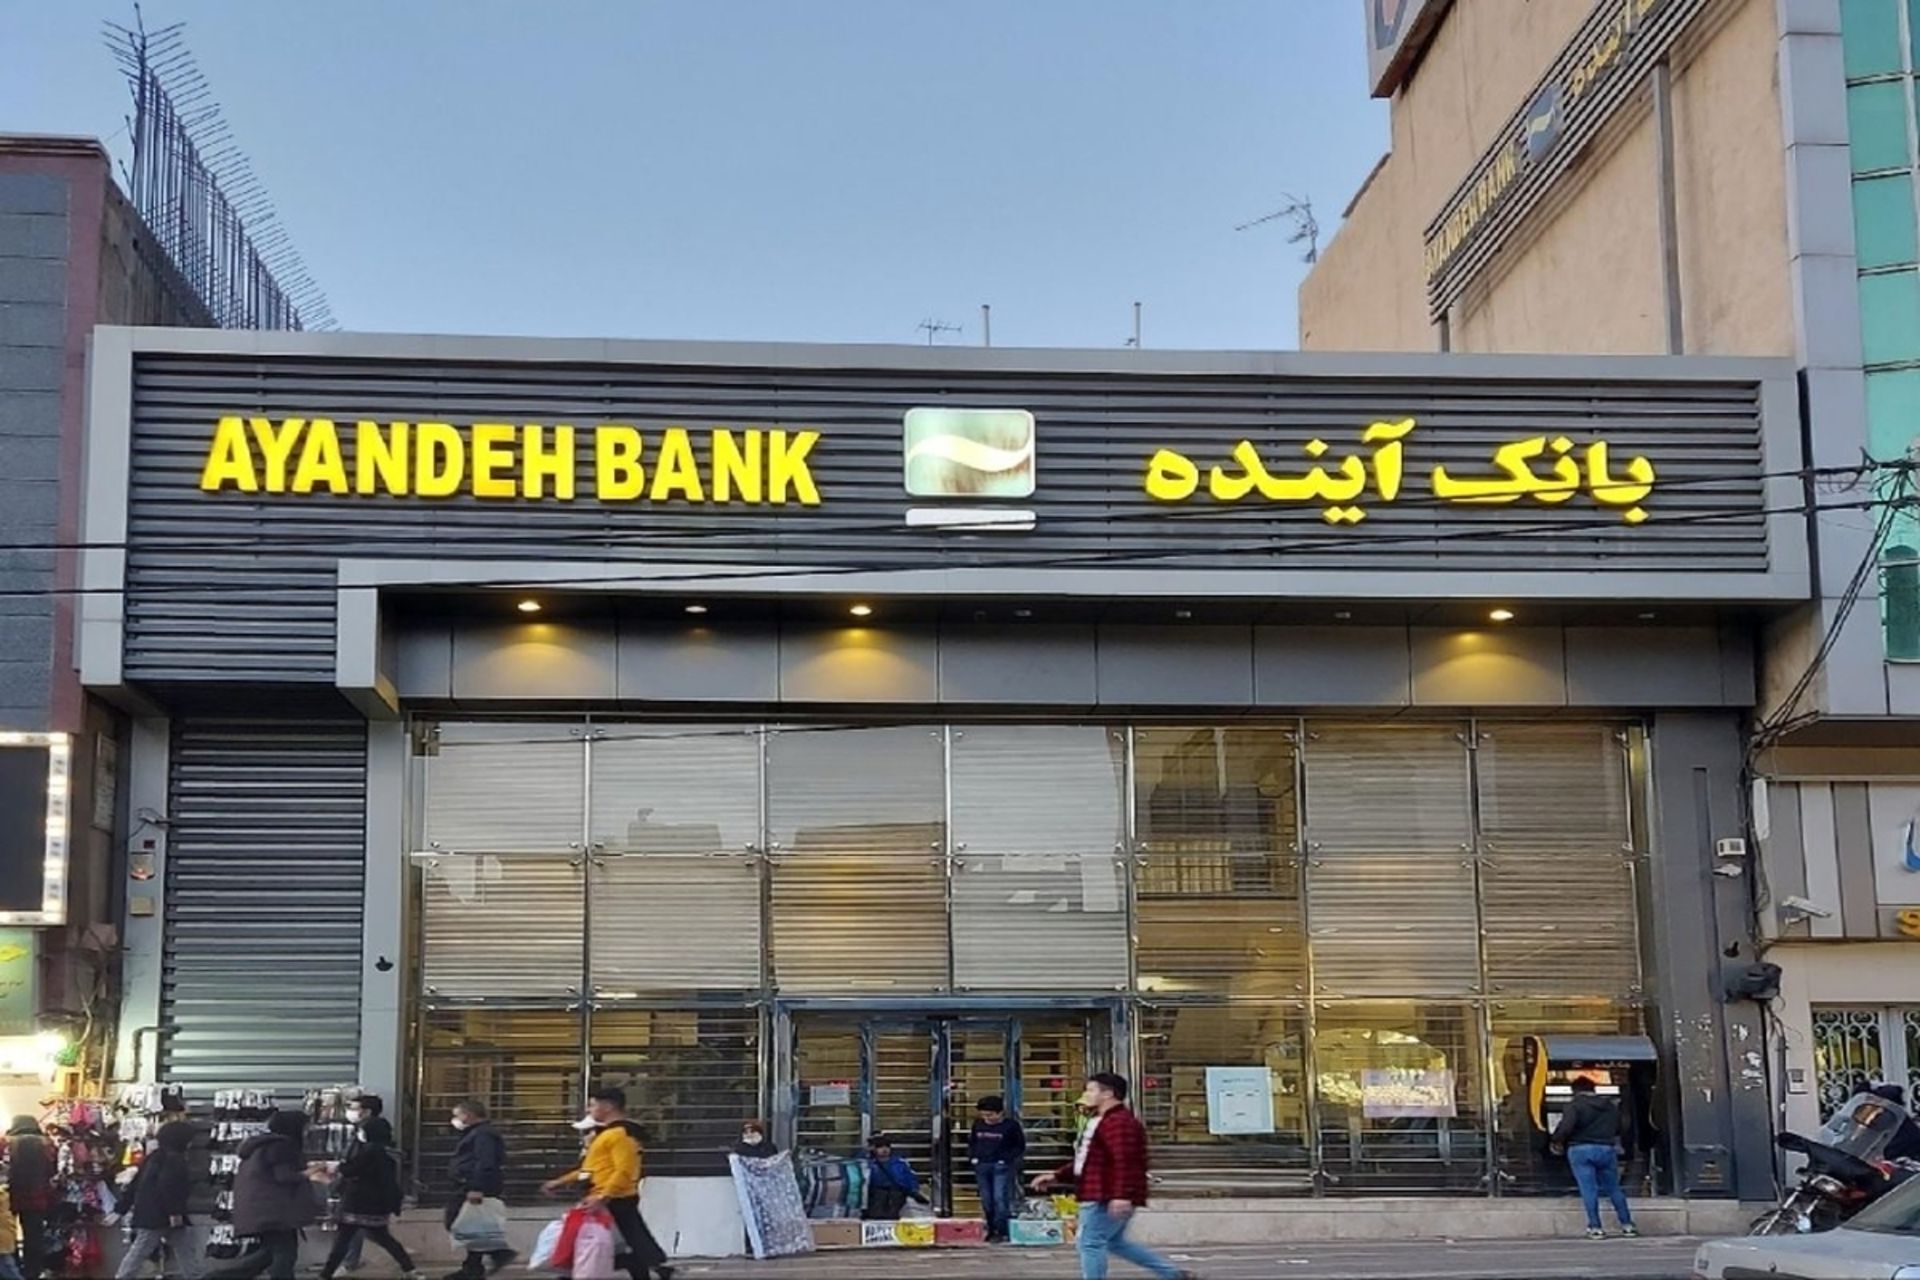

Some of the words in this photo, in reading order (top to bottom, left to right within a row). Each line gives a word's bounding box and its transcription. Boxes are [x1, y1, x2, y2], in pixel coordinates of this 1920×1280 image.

[1479, 143, 1516, 213] BANK
[199, 415, 576, 499] AYANDEH
[594, 426, 820, 505] BANK
[1144, 417, 1416, 524] آینده
[1431, 436, 1656, 523] بانک
